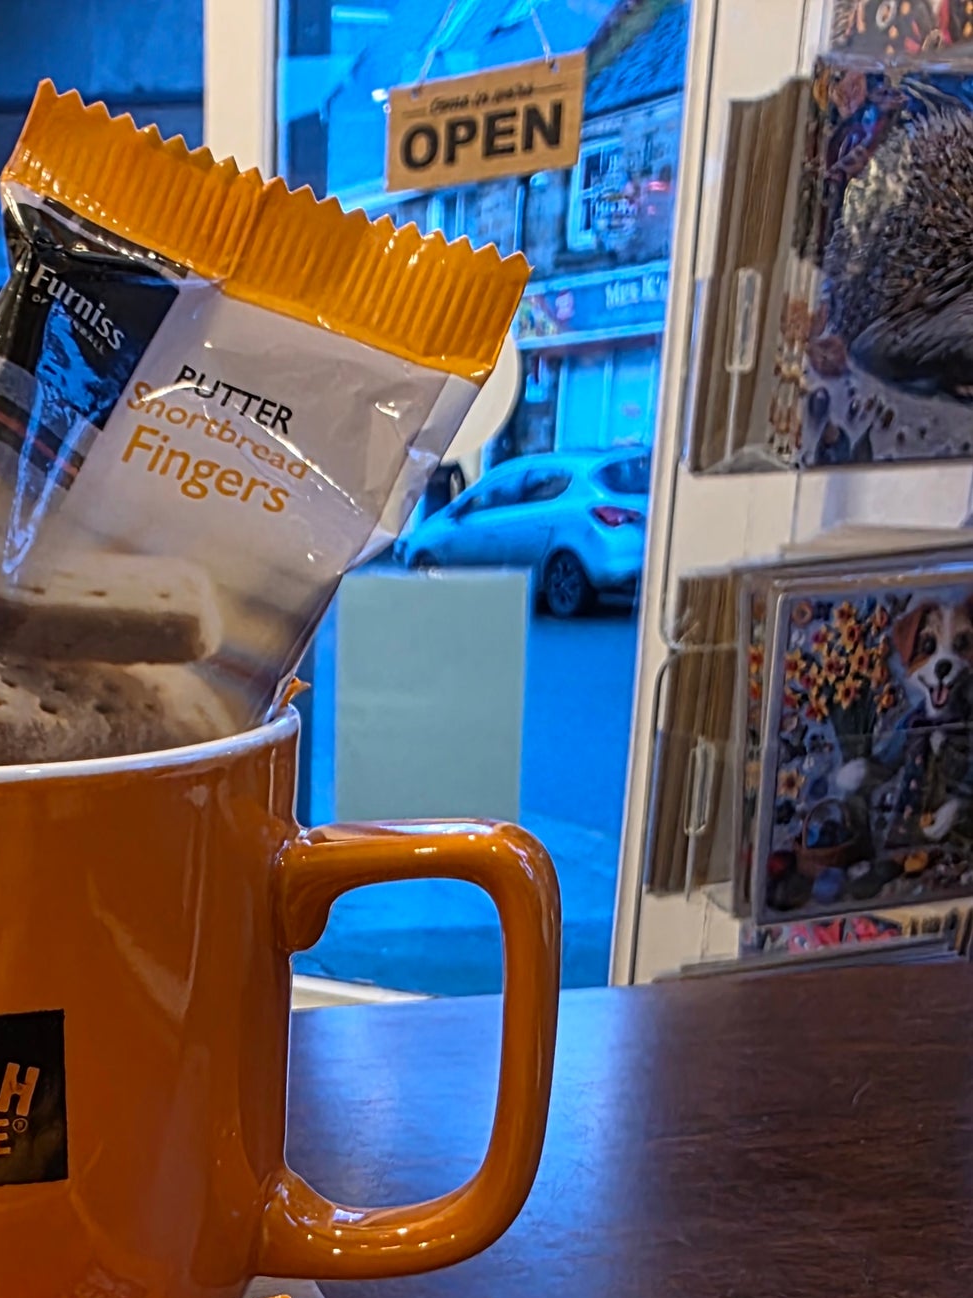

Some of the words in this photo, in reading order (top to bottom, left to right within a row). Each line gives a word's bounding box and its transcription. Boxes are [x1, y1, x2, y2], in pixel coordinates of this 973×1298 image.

[400, 100, 563, 170] OPEN
[30, 264, 125, 350] Furniss
[122, 424, 290, 512] Fingers
